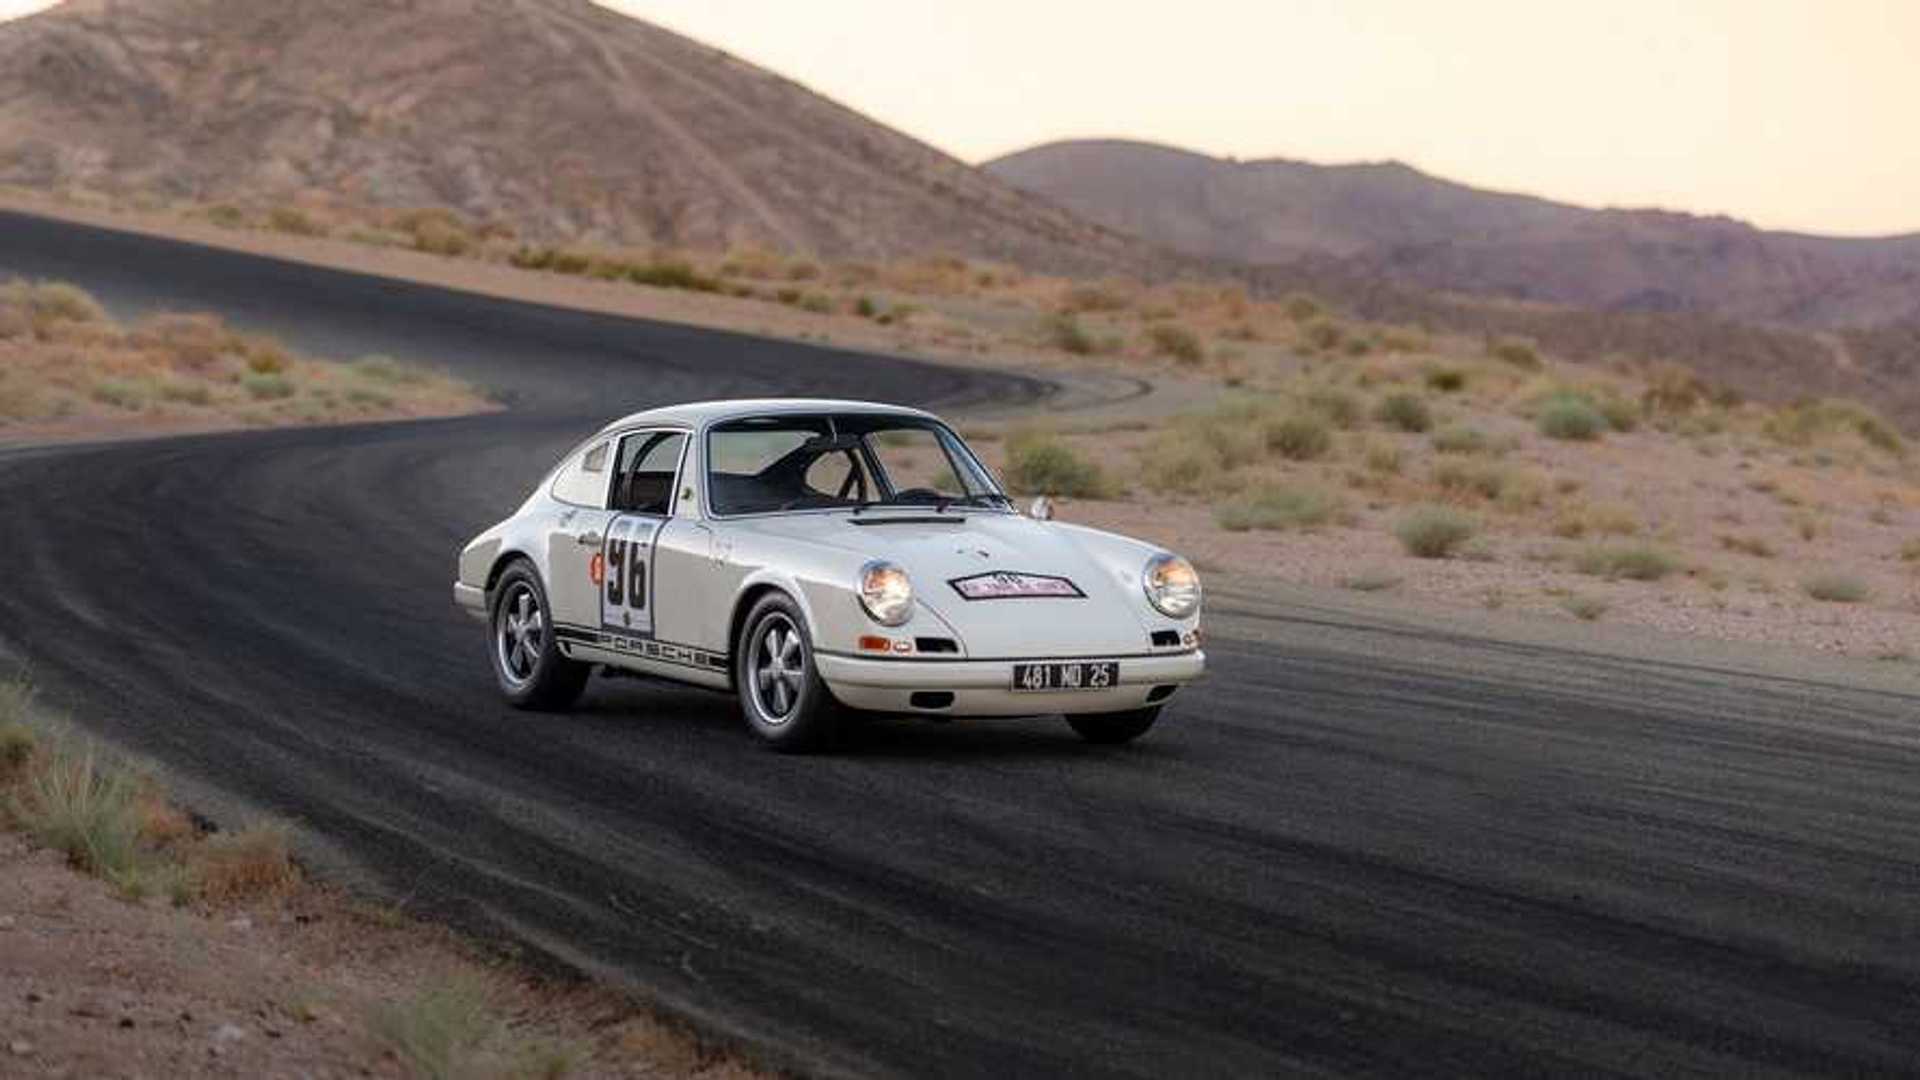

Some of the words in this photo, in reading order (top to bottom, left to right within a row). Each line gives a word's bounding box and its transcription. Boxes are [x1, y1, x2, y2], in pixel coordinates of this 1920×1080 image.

[607, 520, 653, 610] 96
[1023, 664, 1050, 689] 481
[1090, 662, 1110, 687] 25
